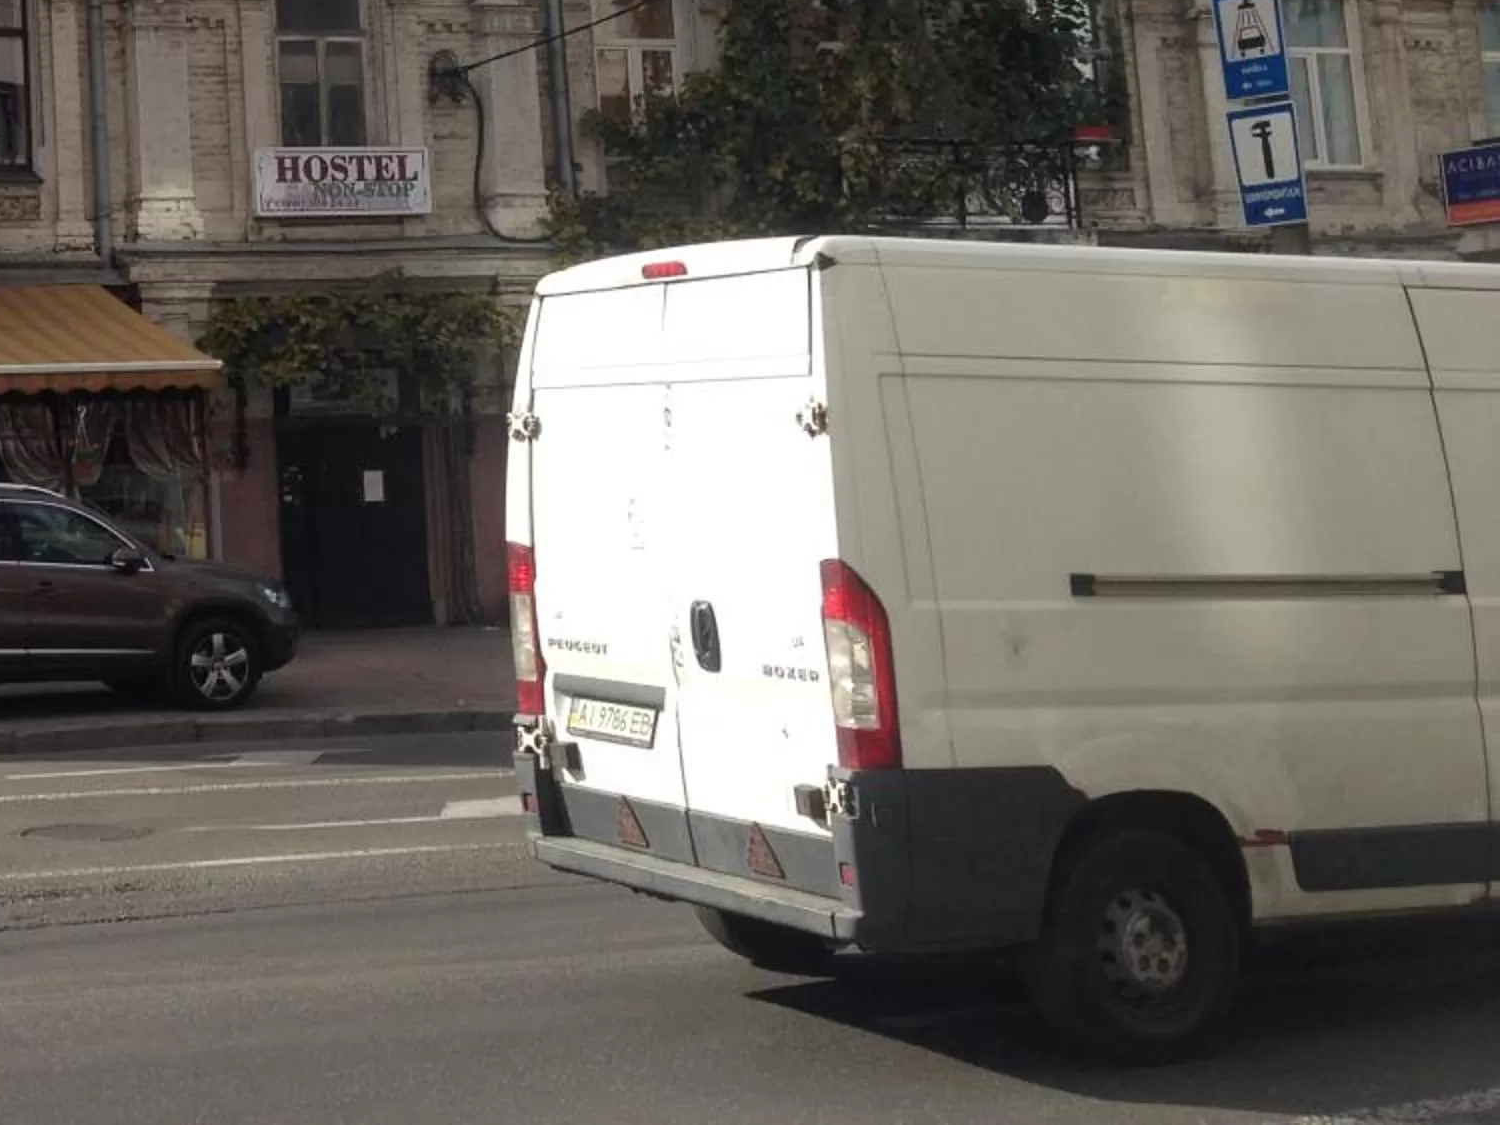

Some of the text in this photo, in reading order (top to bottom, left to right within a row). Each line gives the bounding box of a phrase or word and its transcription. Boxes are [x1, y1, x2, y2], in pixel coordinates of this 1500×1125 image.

[275, 154, 419, 183] HOSTEL
[312, 181, 416, 198] NON-STOP
[547, 637, 608, 655] PEUGEOT
[762, 663, 820, 683] BOXER
